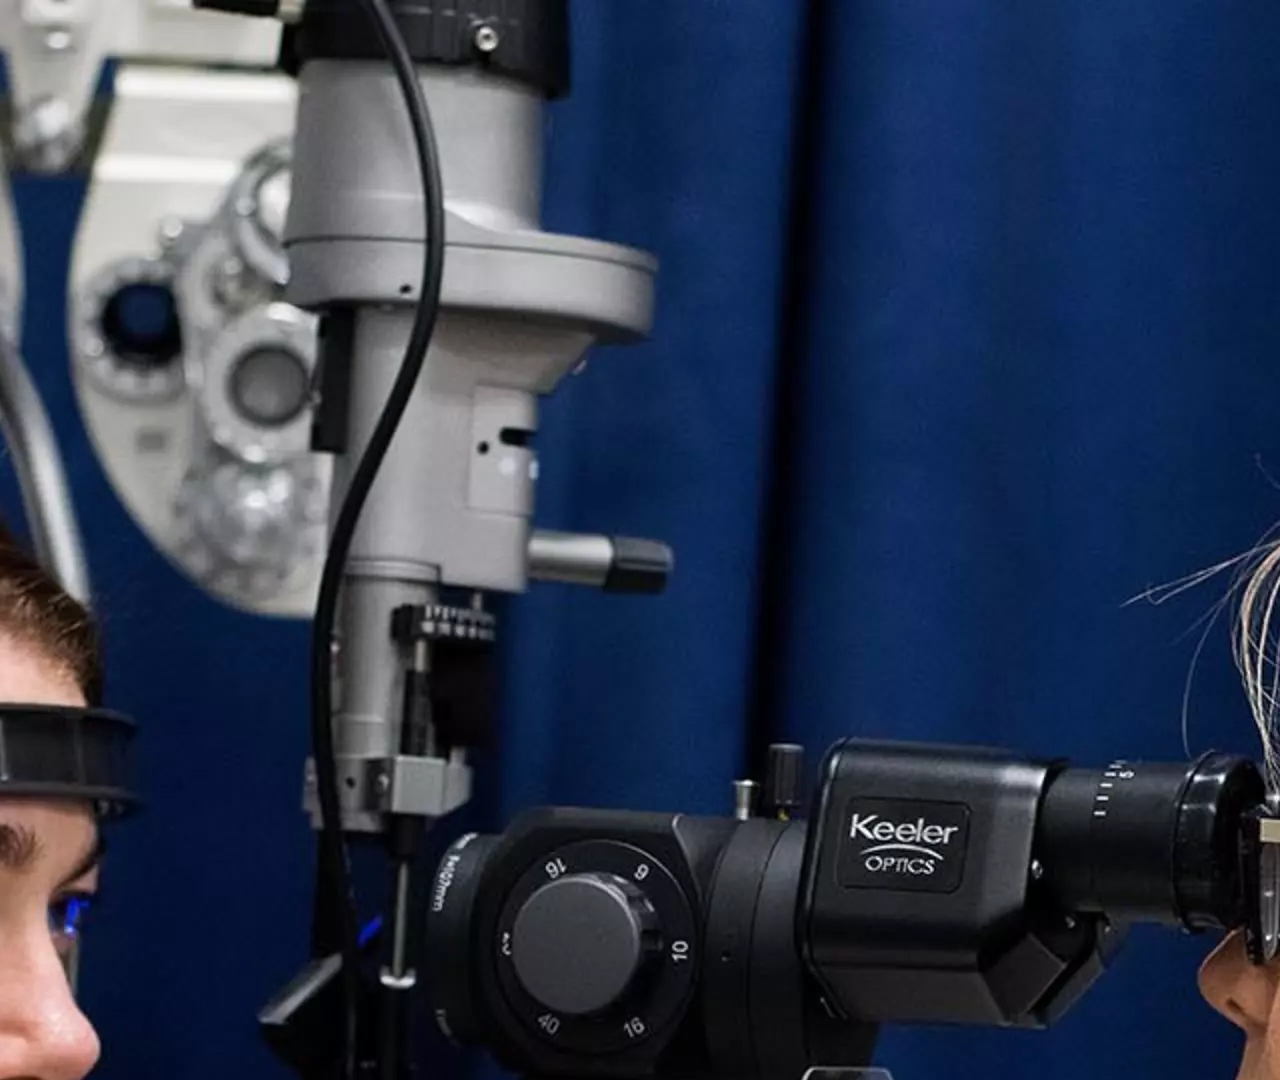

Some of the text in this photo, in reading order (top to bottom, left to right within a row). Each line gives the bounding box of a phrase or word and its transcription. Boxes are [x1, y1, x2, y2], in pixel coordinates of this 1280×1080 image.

[849, 813, 959, 844] Keeler
[545, 858, 567, 879] 16
[864, 856, 936, 875] OPTICS
[671, 941, 688, 961] 10
[538, 1013, 560, 1035] 40
[623, 1016, 645, 1038] 16
